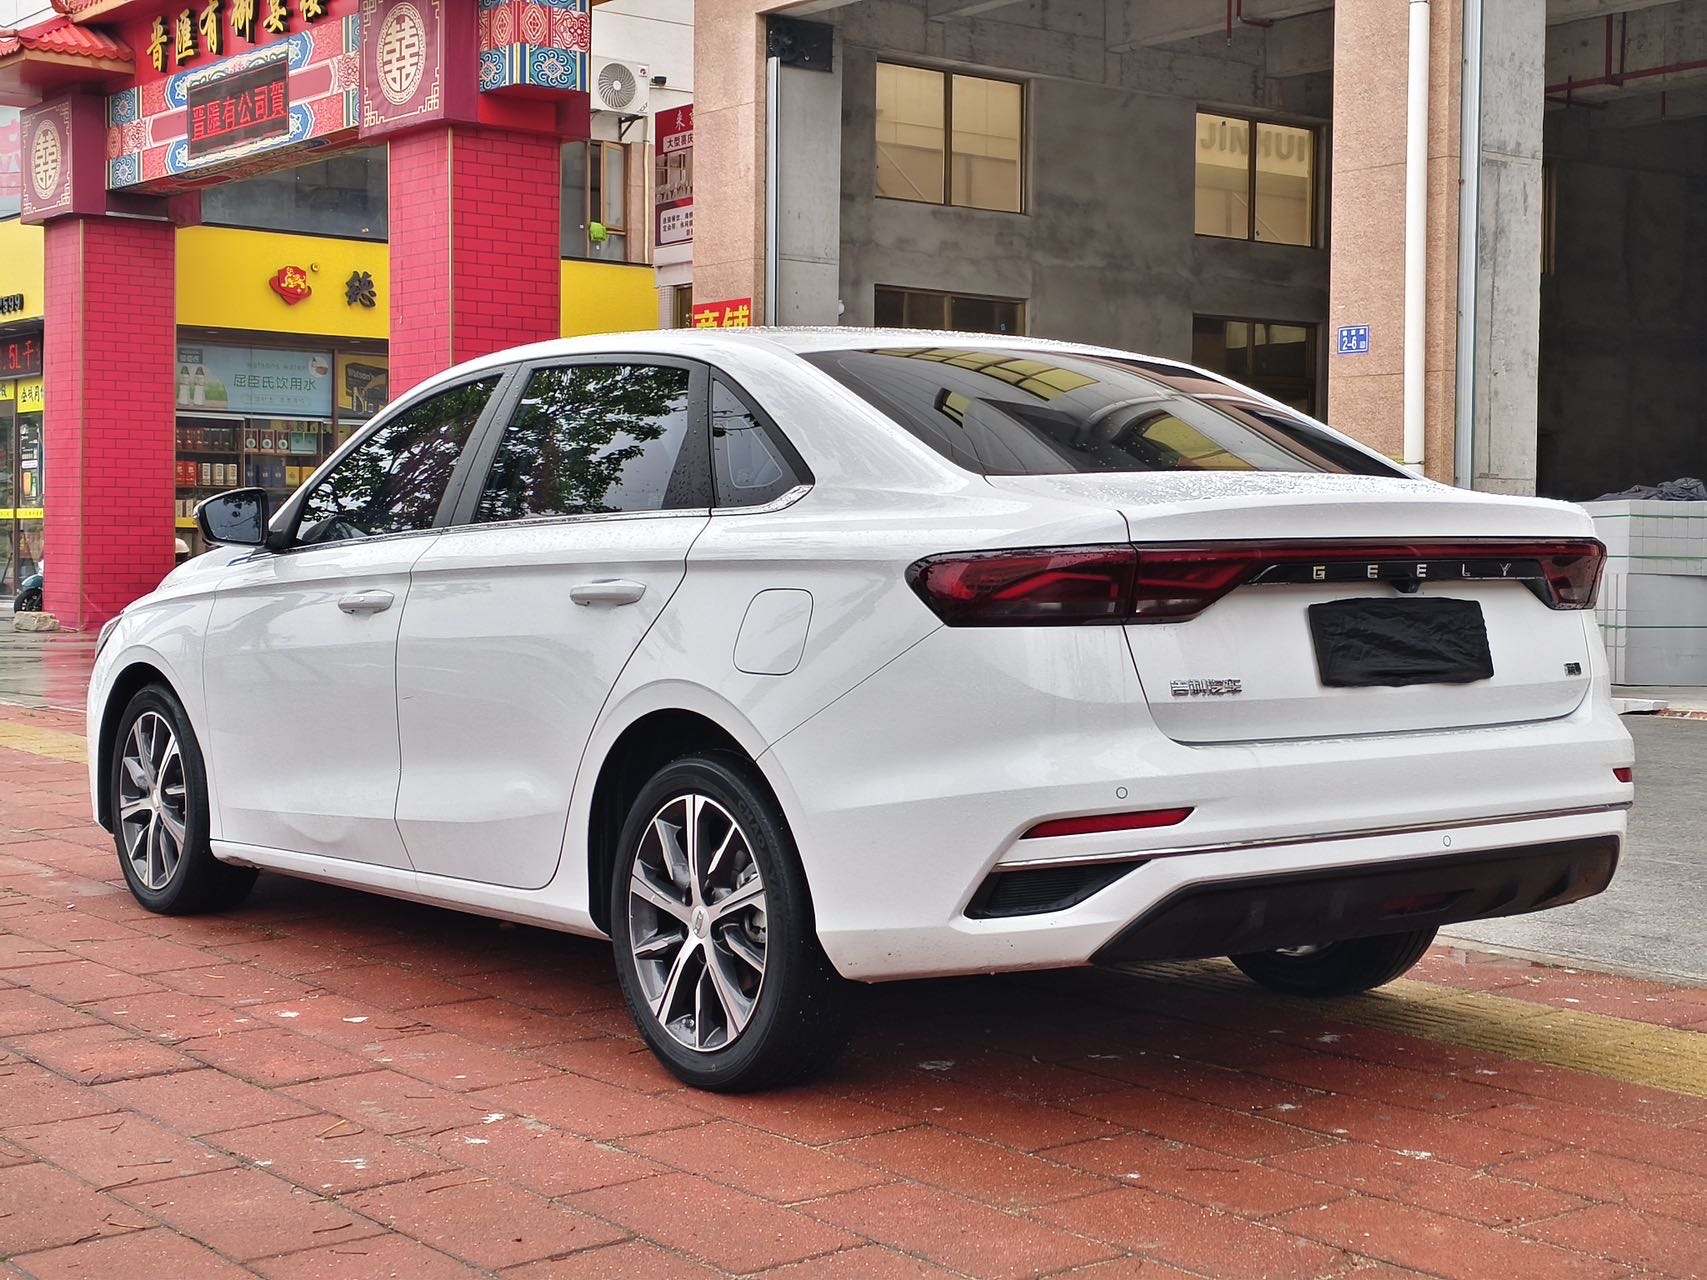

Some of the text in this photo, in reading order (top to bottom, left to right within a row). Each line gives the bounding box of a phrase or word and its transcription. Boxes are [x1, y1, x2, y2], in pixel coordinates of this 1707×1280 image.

[233, 373, 317, 391] 屈臣氏饮用水
[1312, 563, 1512, 580] GEELY
